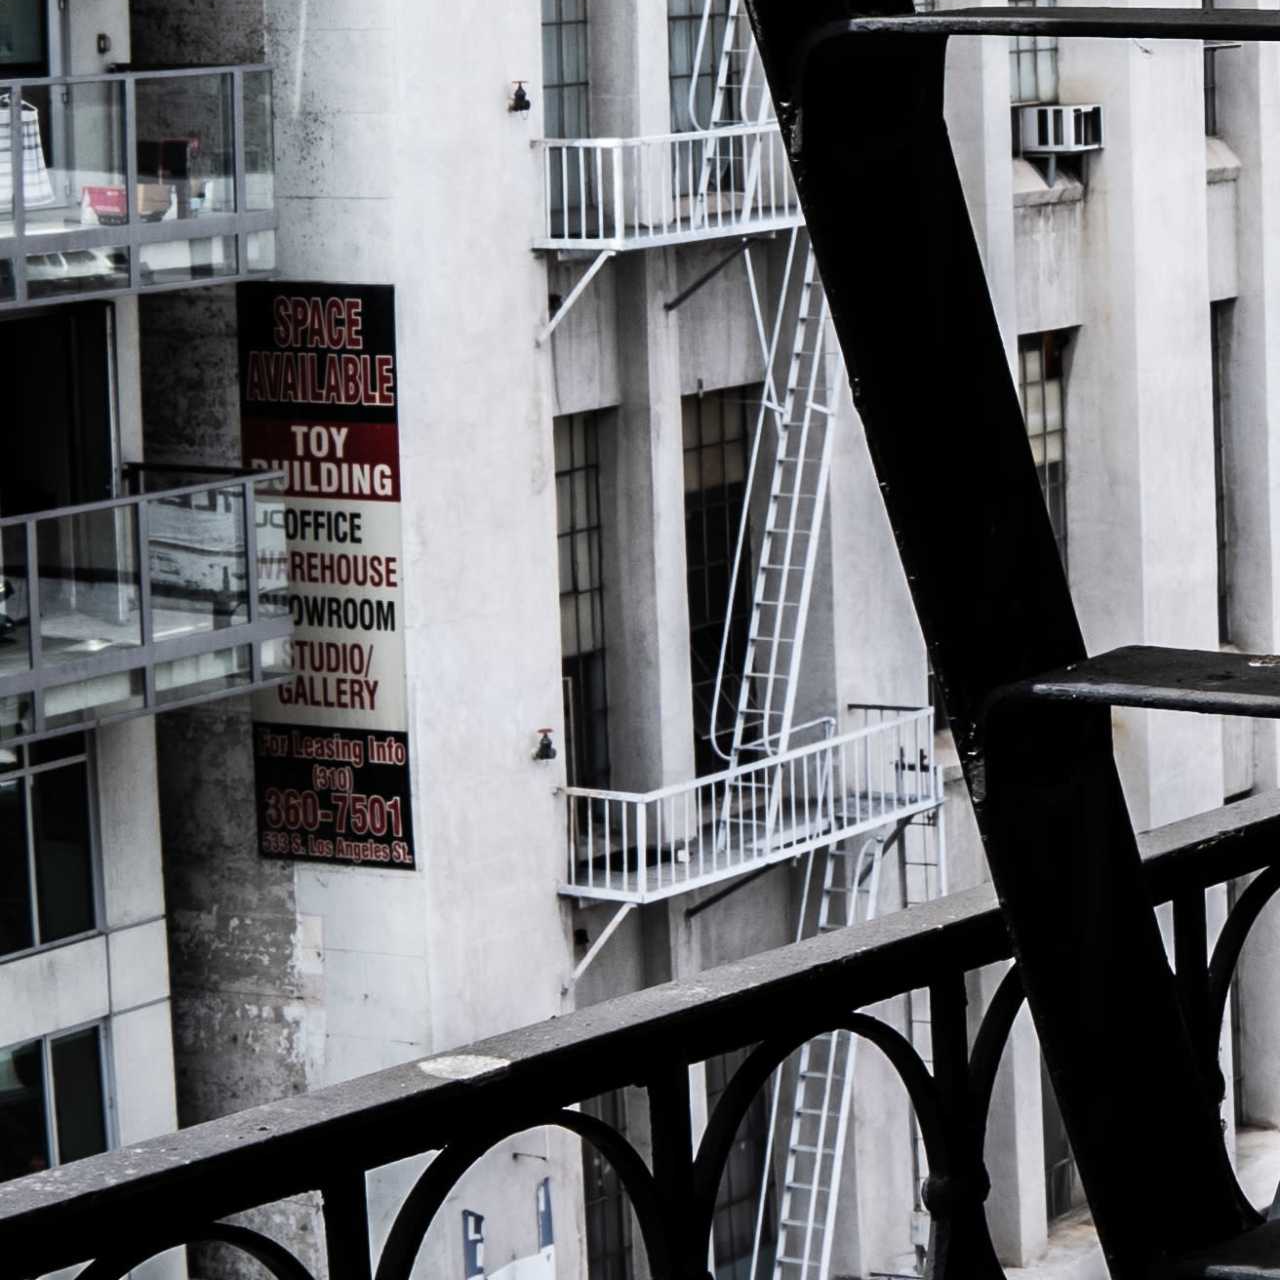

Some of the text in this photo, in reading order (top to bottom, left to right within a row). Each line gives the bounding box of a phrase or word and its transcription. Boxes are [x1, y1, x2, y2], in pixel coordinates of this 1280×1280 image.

[273, 296, 363, 350] SPACE
[247, 351, 394, 406] AVAILABLE
[291, 425, 348, 458] TOY
[284, 508, 362, 544] OFFICE
[258, 593, 395, 632] OWROOM
[278, 675, 378, 710] GALLERY
[257, 728, 406, 768] For Leasing Info
[312, 764, 353, 793] (310)
[264, 786, 403, 838] 360-7501
[262, 831, 413, 864] 533 S. Los Angeles St.
